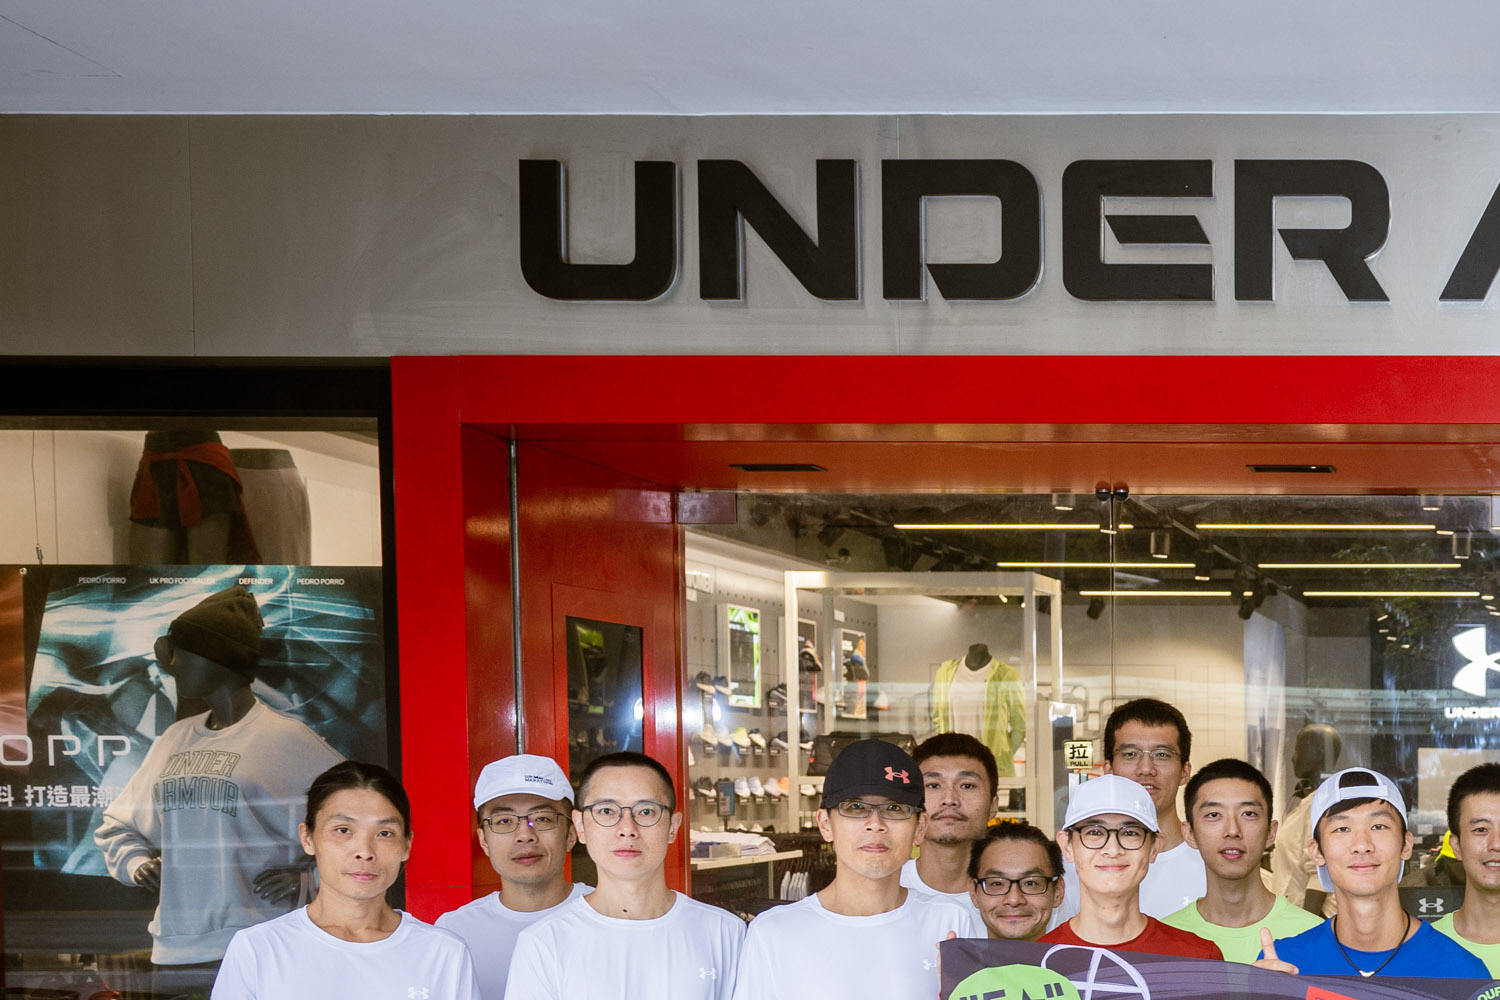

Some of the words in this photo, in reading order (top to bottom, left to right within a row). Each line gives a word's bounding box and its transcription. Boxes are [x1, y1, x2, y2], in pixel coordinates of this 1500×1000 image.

[519, 158, 1392, 303] UNDER
[175, 577, 216, 585] FOOTBALLER
[238, 577, 274, 585] DEFENDER
[1069, 744, 1088, 759] 拉
